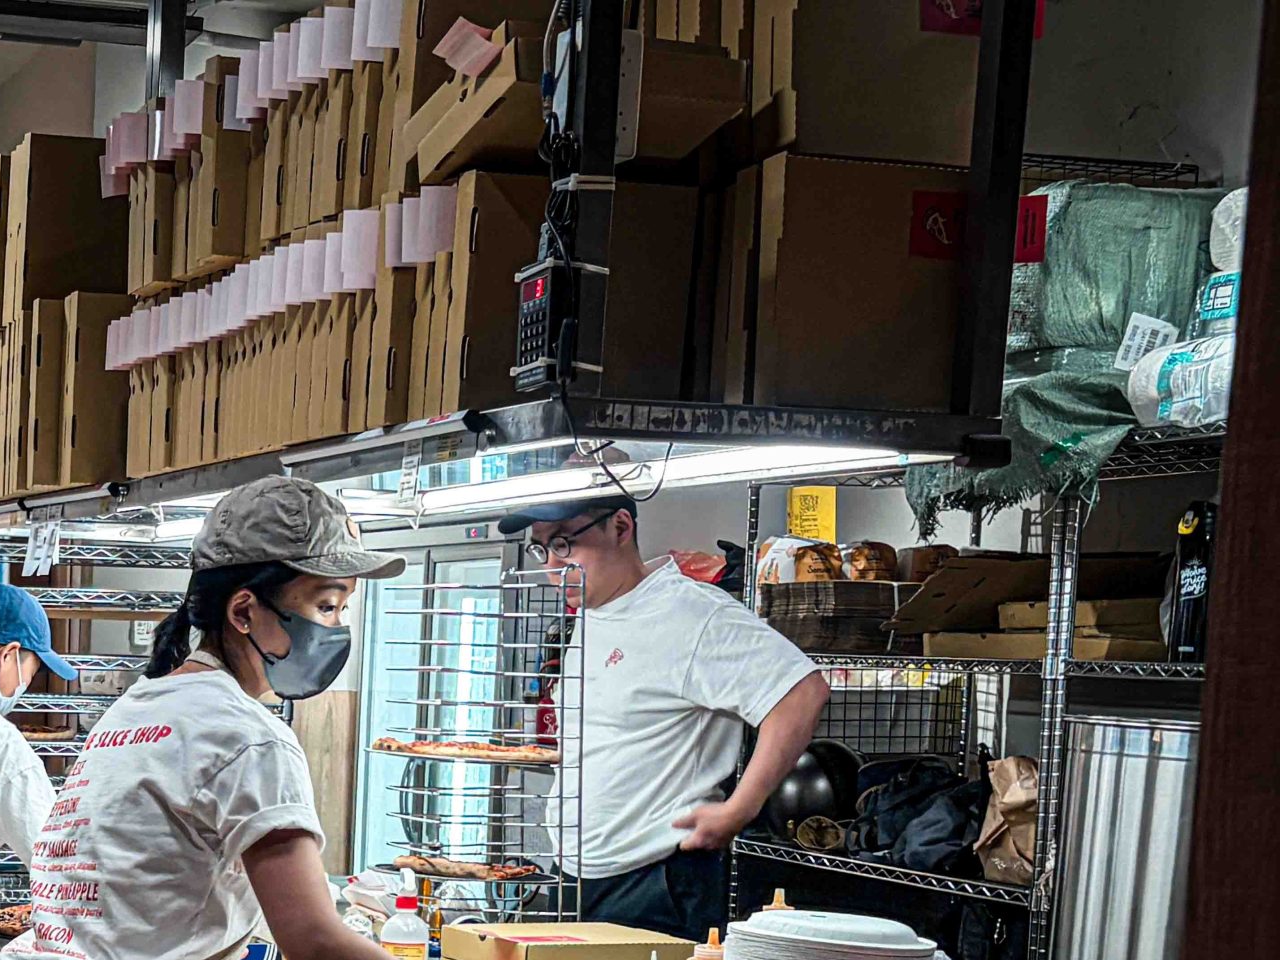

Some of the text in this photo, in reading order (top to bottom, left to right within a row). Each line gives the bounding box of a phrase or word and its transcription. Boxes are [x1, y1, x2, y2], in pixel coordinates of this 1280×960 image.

[94, 730, 132, 748] SLICE
[129, 725, 172, 744] SHOP
[55, 881, 99, 901] PINEAPPLE
[38, 923, 74, 944] BACON
